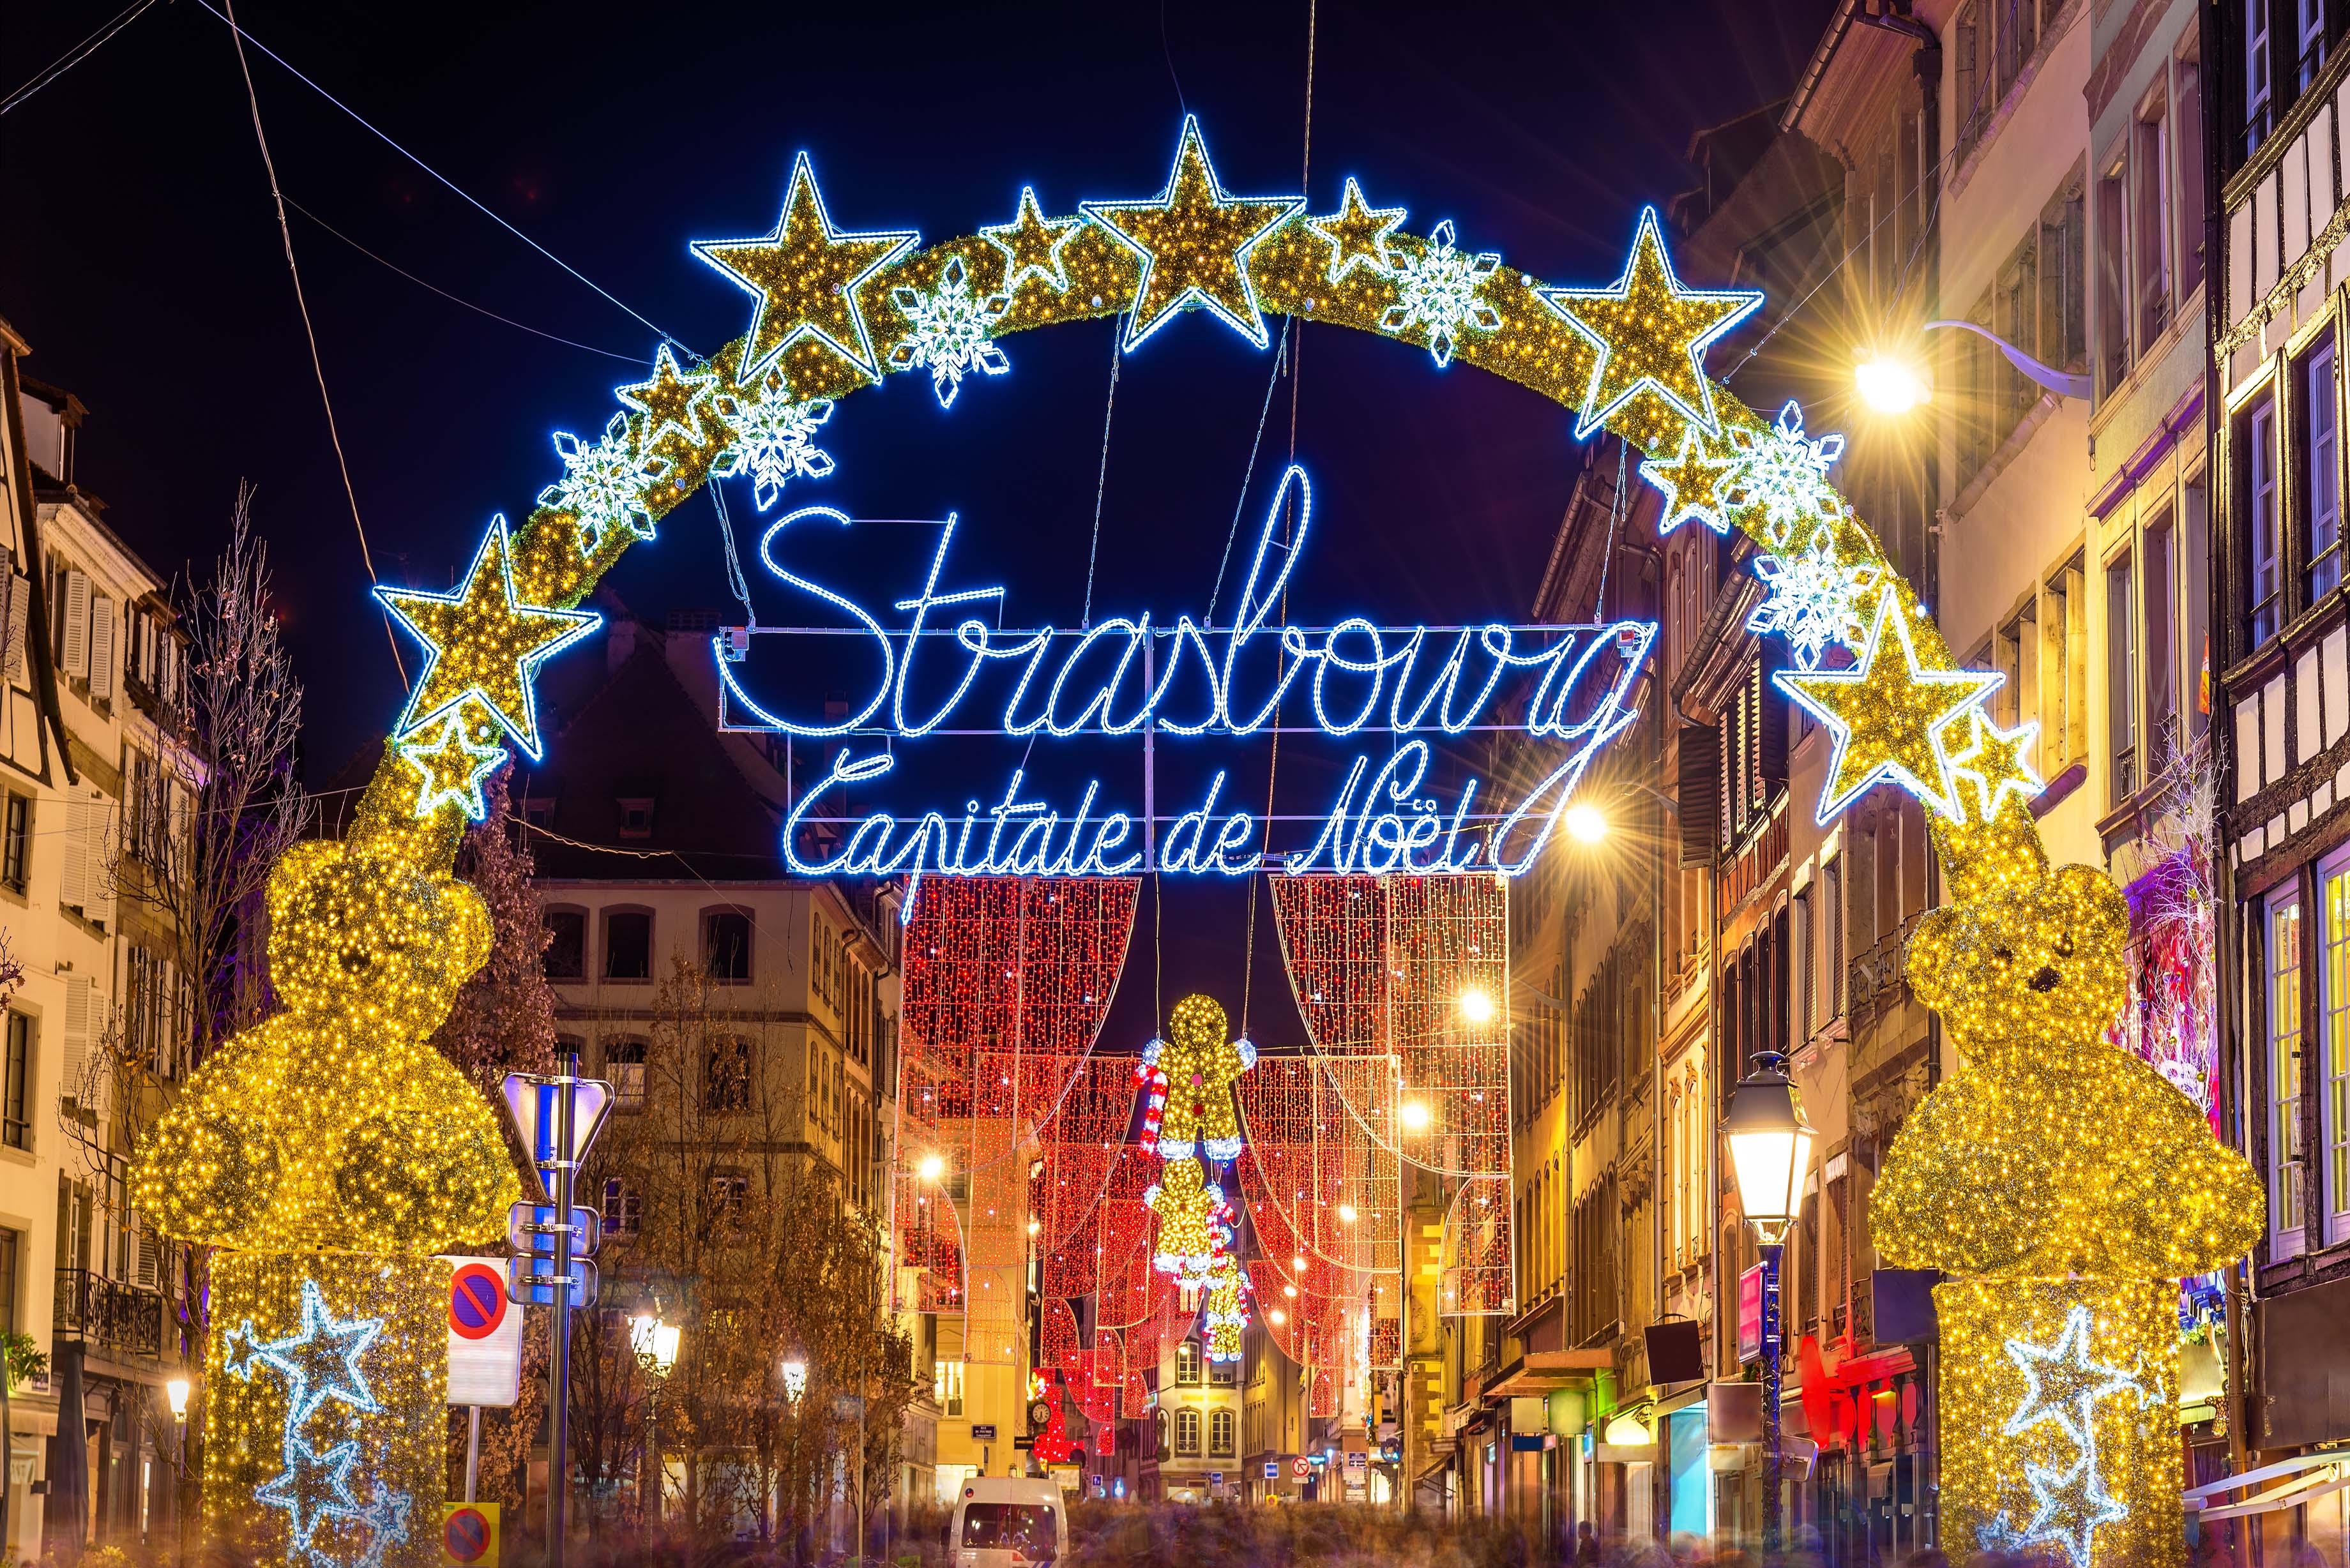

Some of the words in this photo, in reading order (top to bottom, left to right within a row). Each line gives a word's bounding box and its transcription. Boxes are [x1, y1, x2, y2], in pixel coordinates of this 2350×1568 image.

[713, 464, 1658, 877] Strasbourg
[784, 748, 1142, 925] Capitale
[1160, 771, 1262, 875] de
[1288, 739, 1480, 876] Noël
